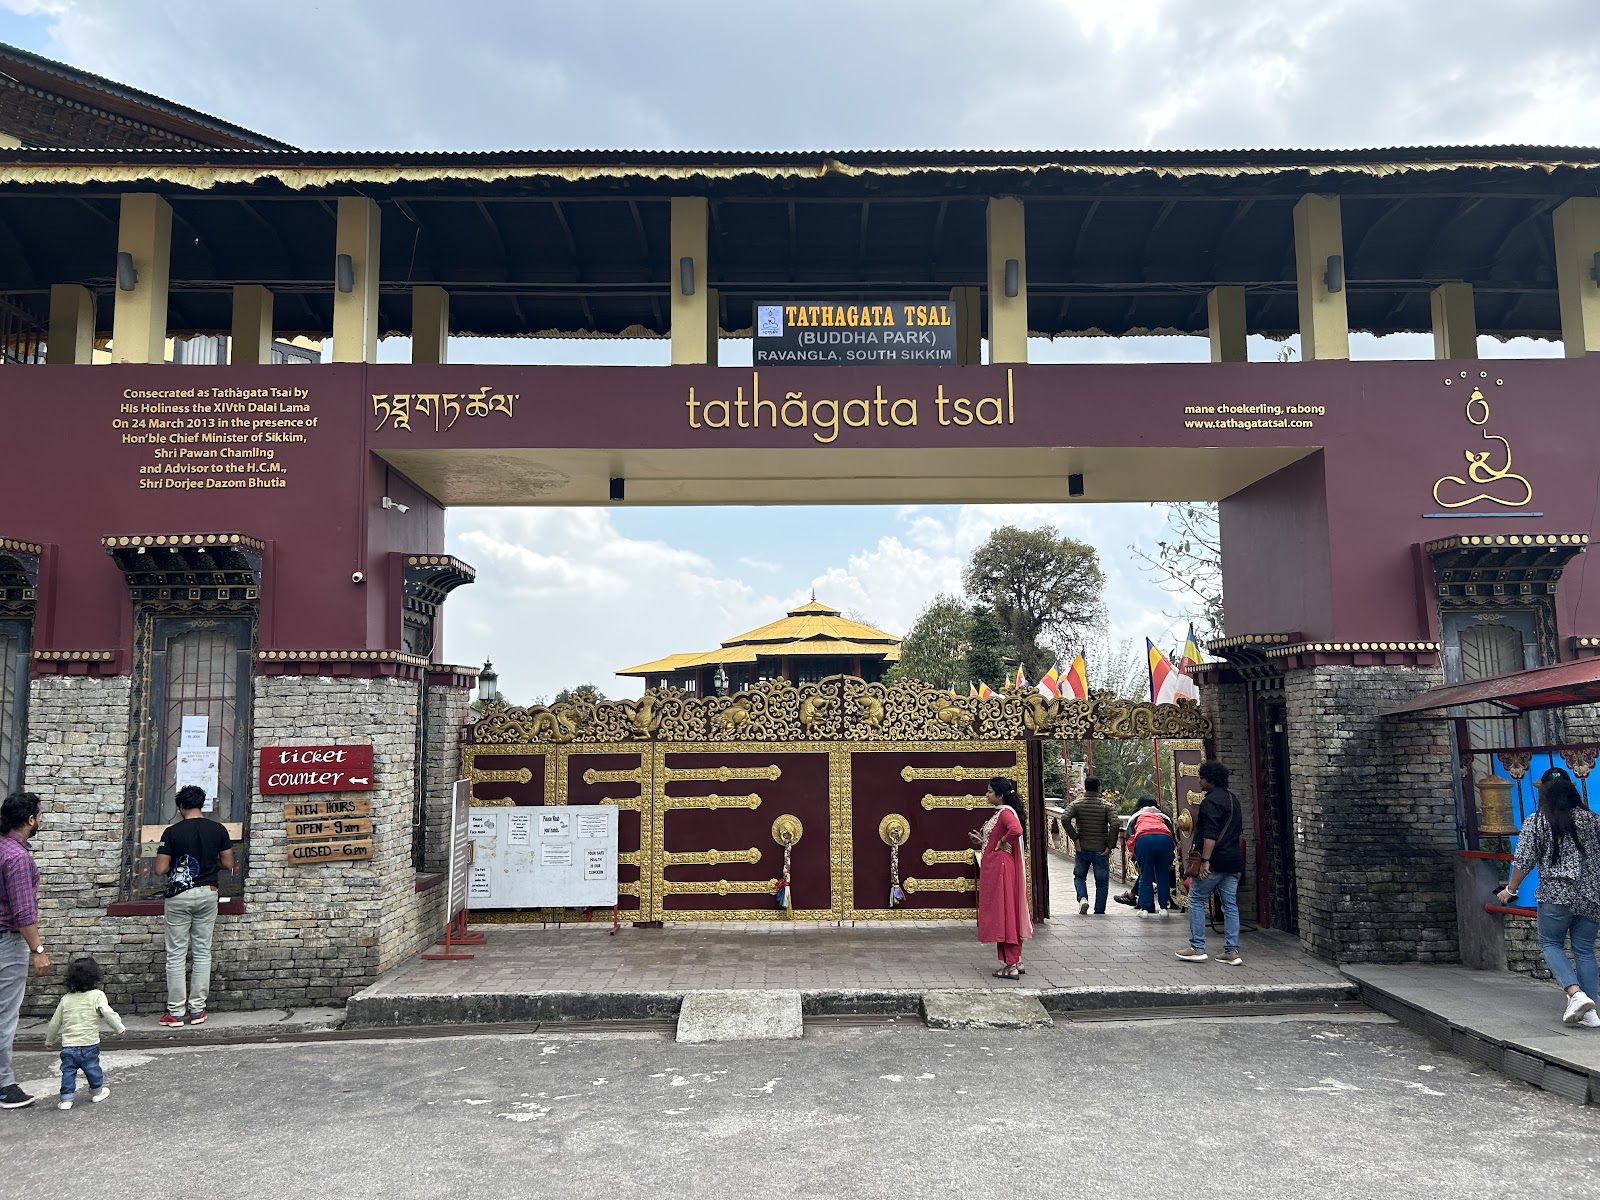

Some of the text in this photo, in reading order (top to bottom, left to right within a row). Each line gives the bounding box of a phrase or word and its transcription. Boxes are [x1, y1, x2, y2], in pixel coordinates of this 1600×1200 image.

[786, 306, 950, 326] TATHAGATA TSAL
[798, 331, 936, 346] (BUDDHA PARK)
[758, 349, 951, 361] RAVANGLA, SOUTH SIKKIM
[123, 388, 195, 399] Consecrated
[294, 388, 308, 399] by
[935, 368, 1014, 426] tsal
[120, 403, 310, 413] His Holiness the XIVth Dalai Lama
[1184, 404, 1325, 415] mane choekerling, rabong
[112, 417, 318, 429] On 24 March 2013 in the presence of
[1184, 418, 1313, 430] www.tathagatatsal.com
[169, 433, 199, 443] Chief
[202, 433, 248, 443] Minister
[251, 432, 263, 442] of
[265, 432, 307, 444] Sikkim,
[154, 448, 274, 459] Shri Pawan Chamling
[140, 463, 287, 474] and Advisor to the H.C.M.,
[139, 477, 286, 490] Shri Dorjee Dazom Bhutia
[279, 750, 347, 764] ticket
[268, 771, 344, 786] counter
[295, 802, 355, 815] NEW HOURS
[296, 823, 323, 834] OPEN
[293, 846, 331, 858] CLOSED
